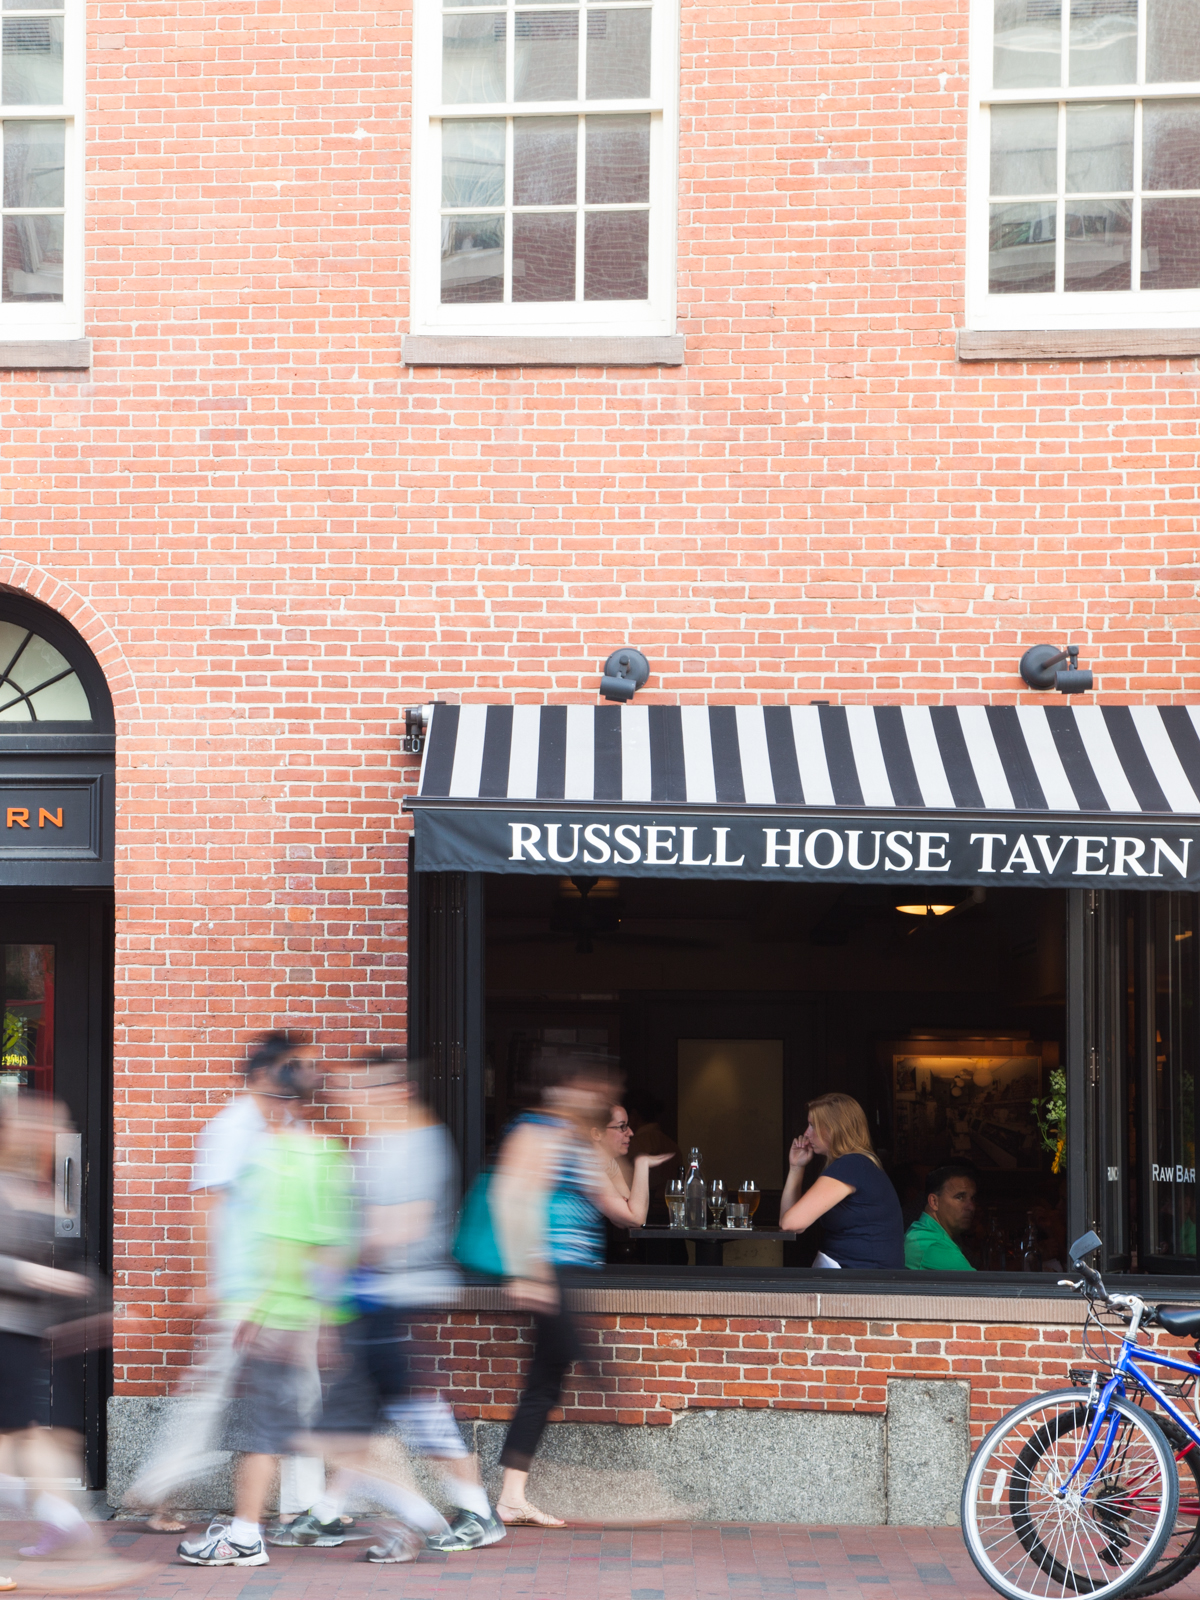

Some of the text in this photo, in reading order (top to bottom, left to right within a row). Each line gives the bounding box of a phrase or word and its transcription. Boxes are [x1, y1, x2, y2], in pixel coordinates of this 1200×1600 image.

[507, 822, 1194, 879] RUSSELL HOUSE TAVERN
[1152, 1163, 1196, 1183] RAW BAR
[216, 1544, 233, 1558] N
